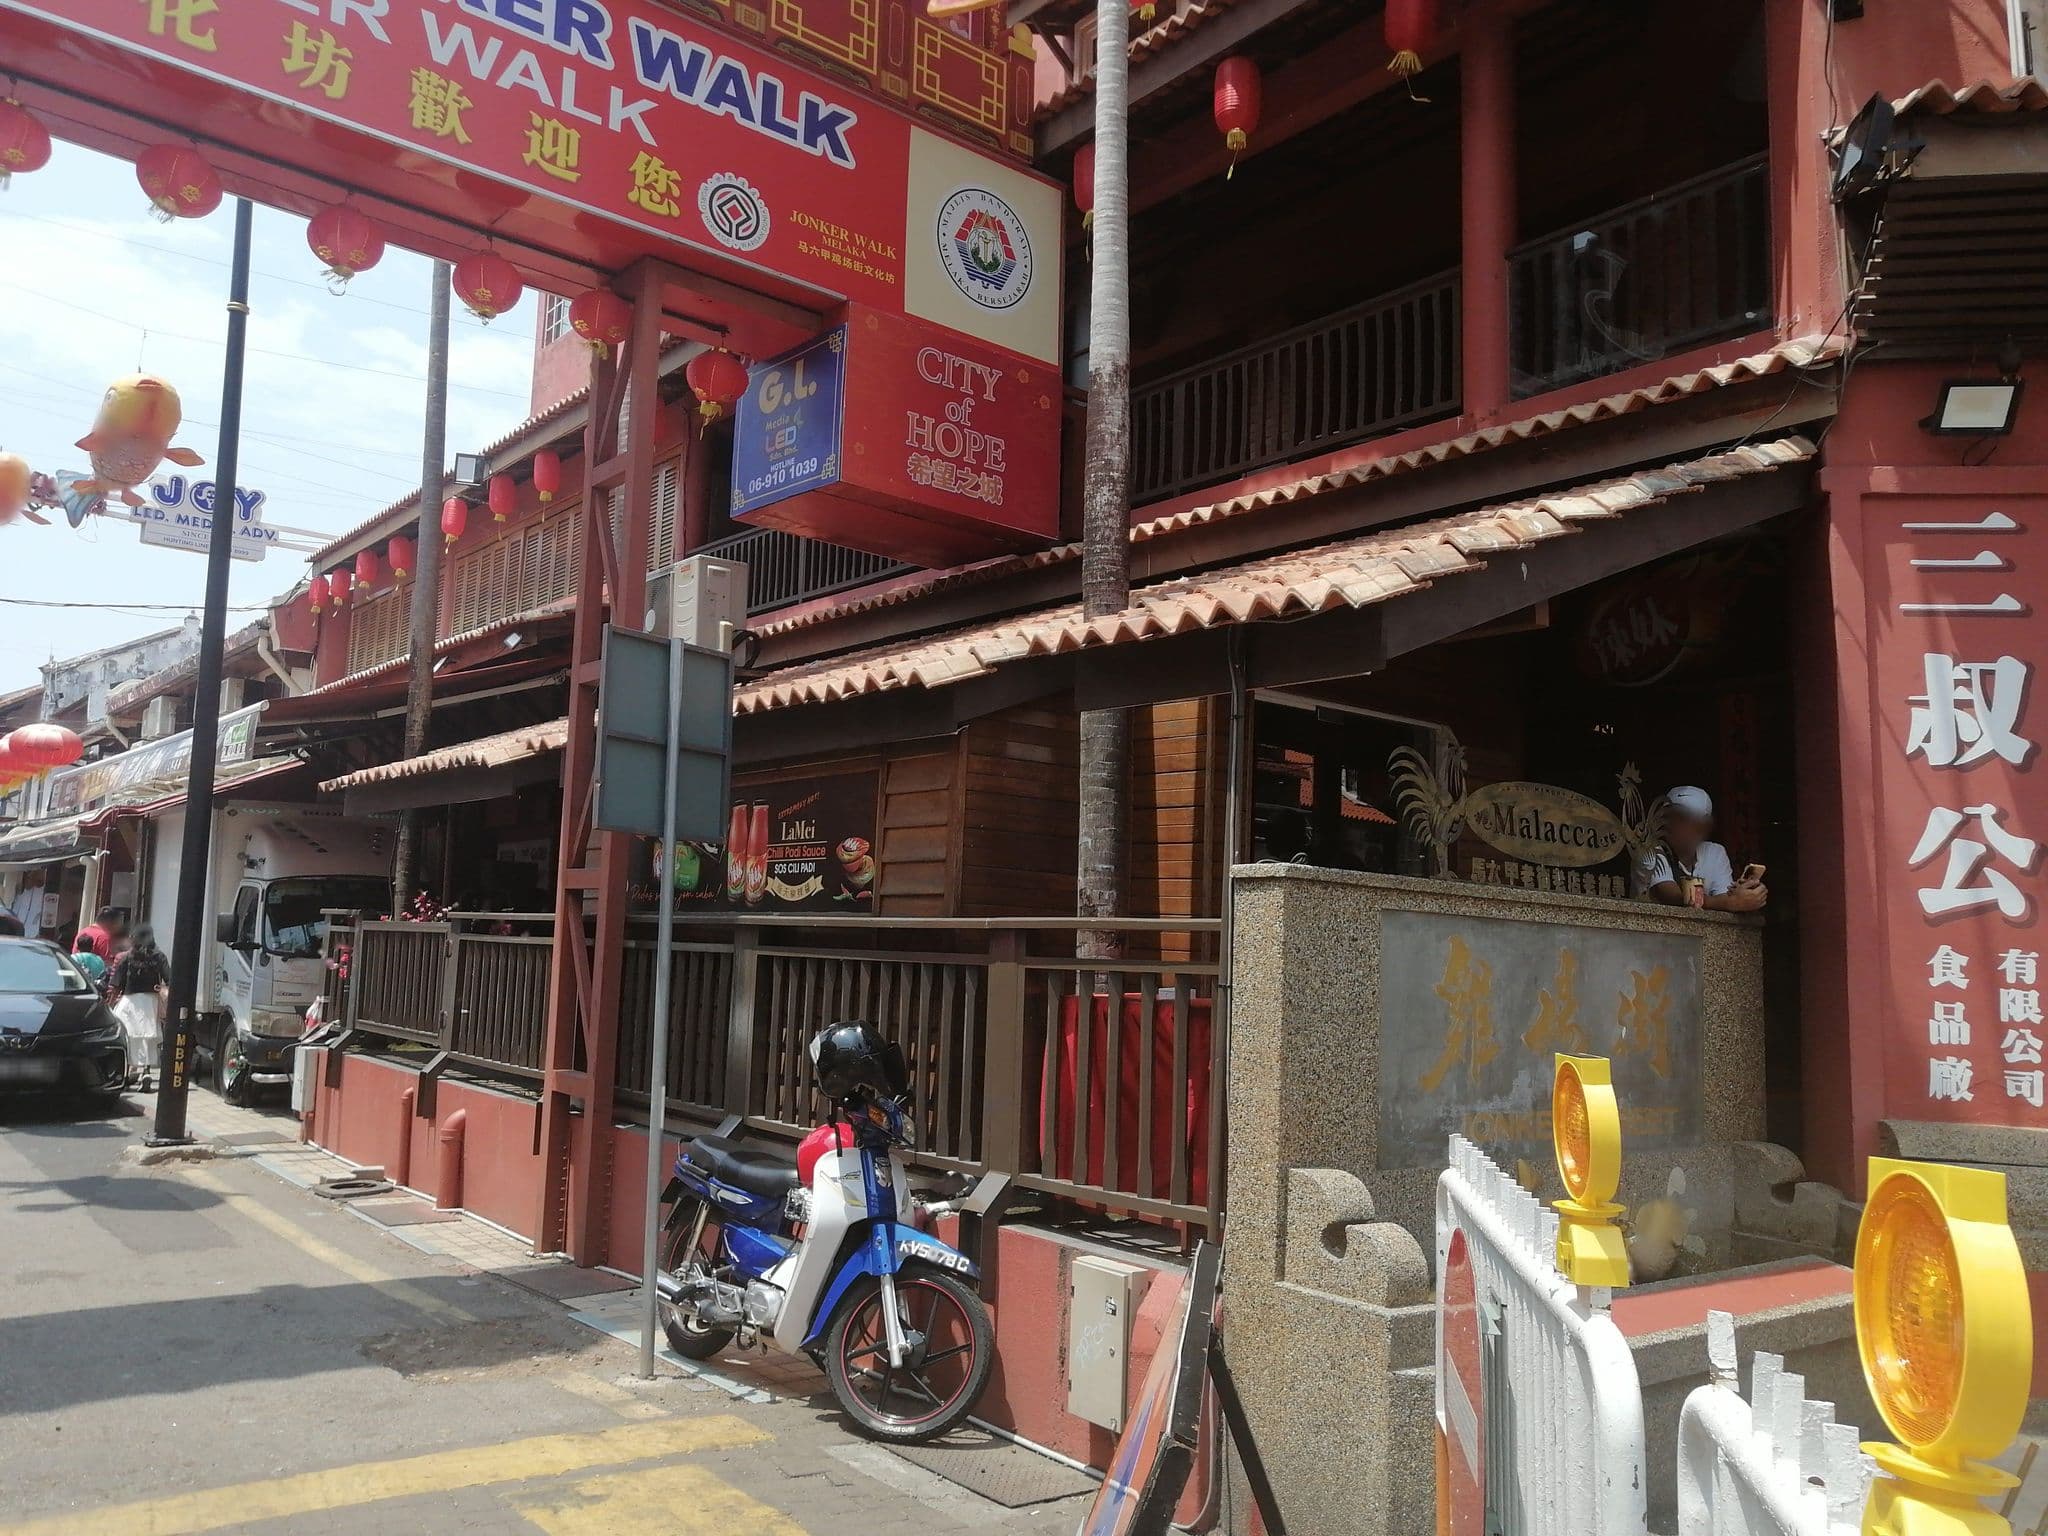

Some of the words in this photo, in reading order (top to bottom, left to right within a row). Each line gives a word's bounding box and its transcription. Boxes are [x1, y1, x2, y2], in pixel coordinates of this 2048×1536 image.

[421, 9, 661, 147] WALK
[460, 0, 612, 66] ER
[632, 19, 854, 165] WALK
[790, 210, 849, 242] JONKER
[854, 232, 897, 260] WALK
[822, 235, 867, 260] MELAKA
[942, 194, 971, 227] MAJLIS
[980, 194, 1029, 260] BANDARAYA
[940, 242, 970, 294] MELAKA
[976, 272, 1029, 306] BERSEJARAH
[758, 358, 817, 415] G.L.
[916, 346, 1003, 402] CITY
[765, 415, 790, 432] Media
[945, 397, 976, 426] of
[766, 425, 798, 454] LED
[770, 457, 796, 473] HOTLINE
[905, 411, 1006, 472] HOPE
[749, 468, 786, 494] 06-910
[789, 457, 818, 480] 1039
[907, 453, 1004, 505] 希望之城
[133, 507, 169, 523] LED.
[240, 526, 278, 542] ADV.
[1899, 512, 2035, 917] 三叔公
[781, 819, 816, 841] LaMei
[1490, 801, 1600, 849] Malacca
[774, 864, 787, 874] SOS
[788, 863, 800, 874] CILI
[800, 862, 816, 873] PADI
[785, 846, 801, 858] Padi
[802, 845, 826, 857] Sauce
[1926, 945, 1974, 1101] 食品廠
[1998, 948, 2045, 1107] 有限公司
[173, 1033, 186, 1088] MBMB
